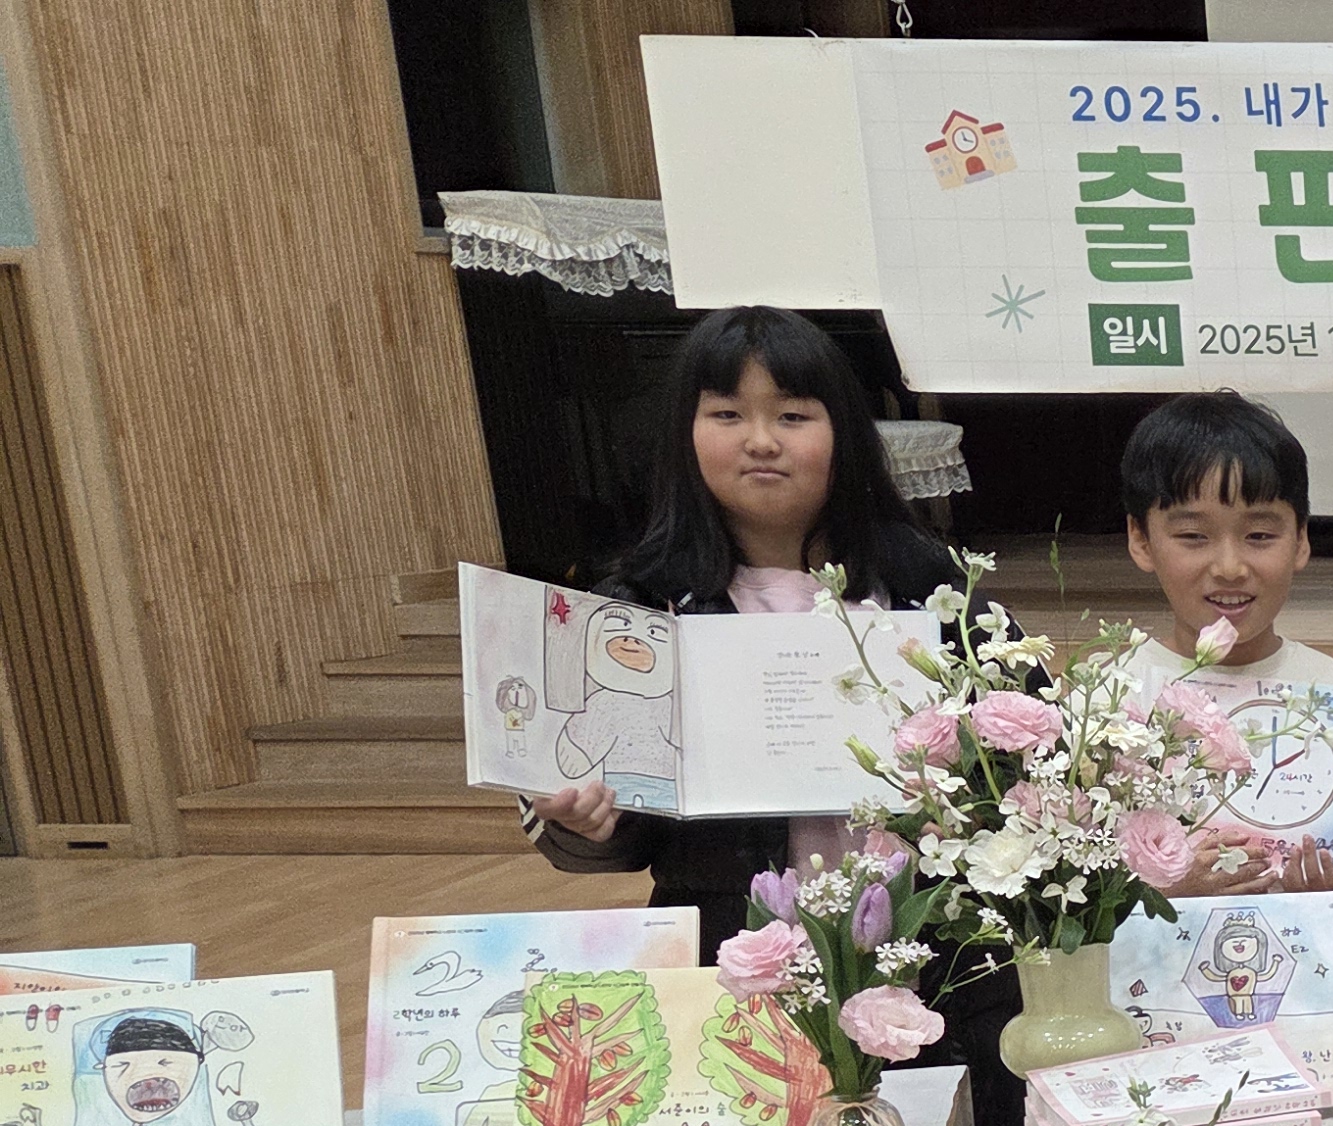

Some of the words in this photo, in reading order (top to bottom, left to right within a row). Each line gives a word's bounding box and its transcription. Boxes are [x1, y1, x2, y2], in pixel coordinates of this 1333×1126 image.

[1072, 85, 1219, 124] 2025.
[1245, 82, 1328, 127] 내가
[1102, 316, 1169, 355] 일시
[1198, 322, 1318, 358] 2025년
[393, 1008, 435, 1022] 2학년의
[438, 1007, 461, 1018] 하루
[0, 1059, 47, 1075] 우시안
